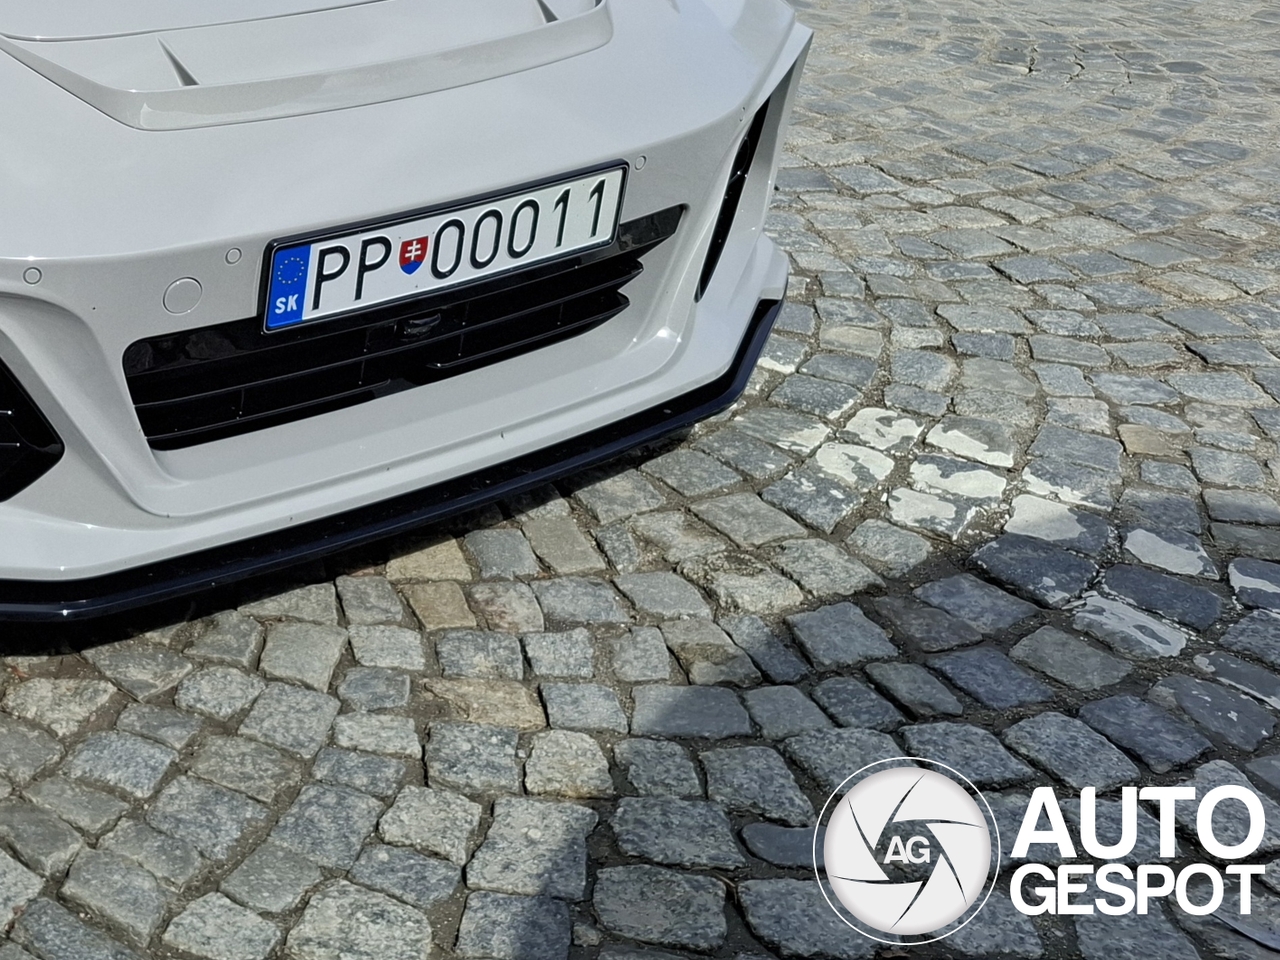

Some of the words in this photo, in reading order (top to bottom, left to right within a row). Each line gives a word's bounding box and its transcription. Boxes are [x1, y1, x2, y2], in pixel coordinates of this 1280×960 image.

[311, 235, 393, 311] PP
[429, 177, 607, 280] 00011
[275, 293, 299, 315] SK
